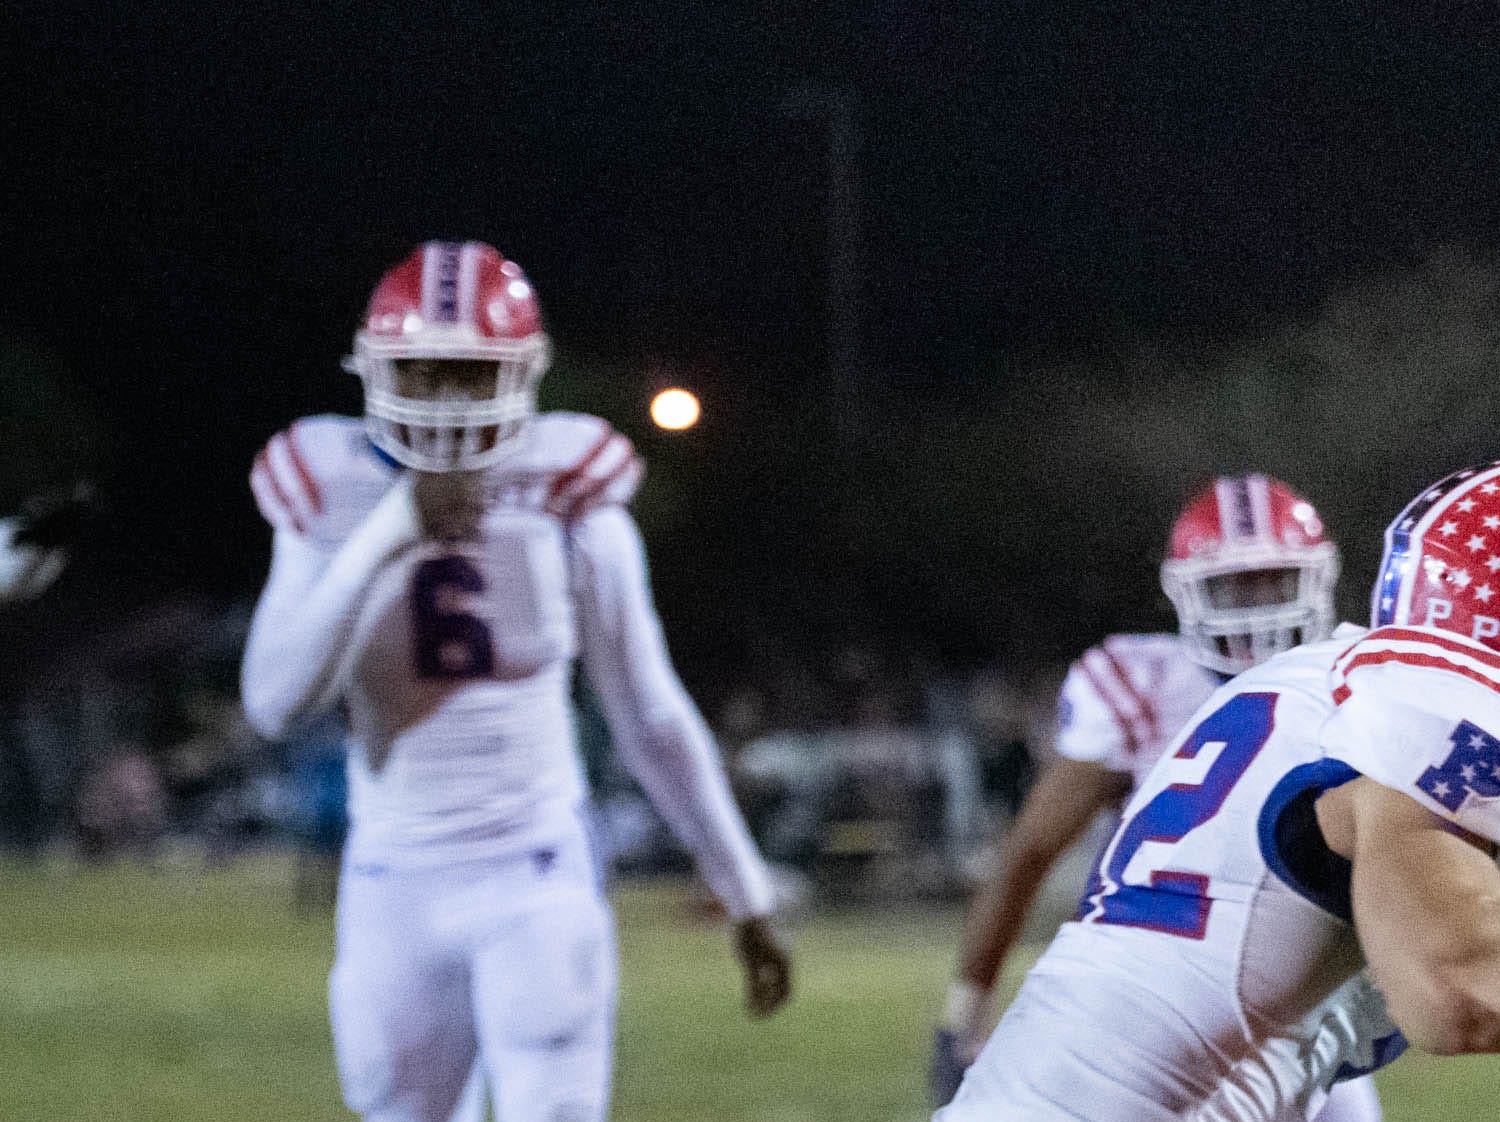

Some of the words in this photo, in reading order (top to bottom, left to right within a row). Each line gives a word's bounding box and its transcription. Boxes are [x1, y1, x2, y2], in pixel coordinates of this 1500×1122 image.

[411, 551, 495, 679] 6
[1424, 597, 1453, 628] P
[1471, 613, 1500, 641] P
[1077, 692, 1280, 941] 2
